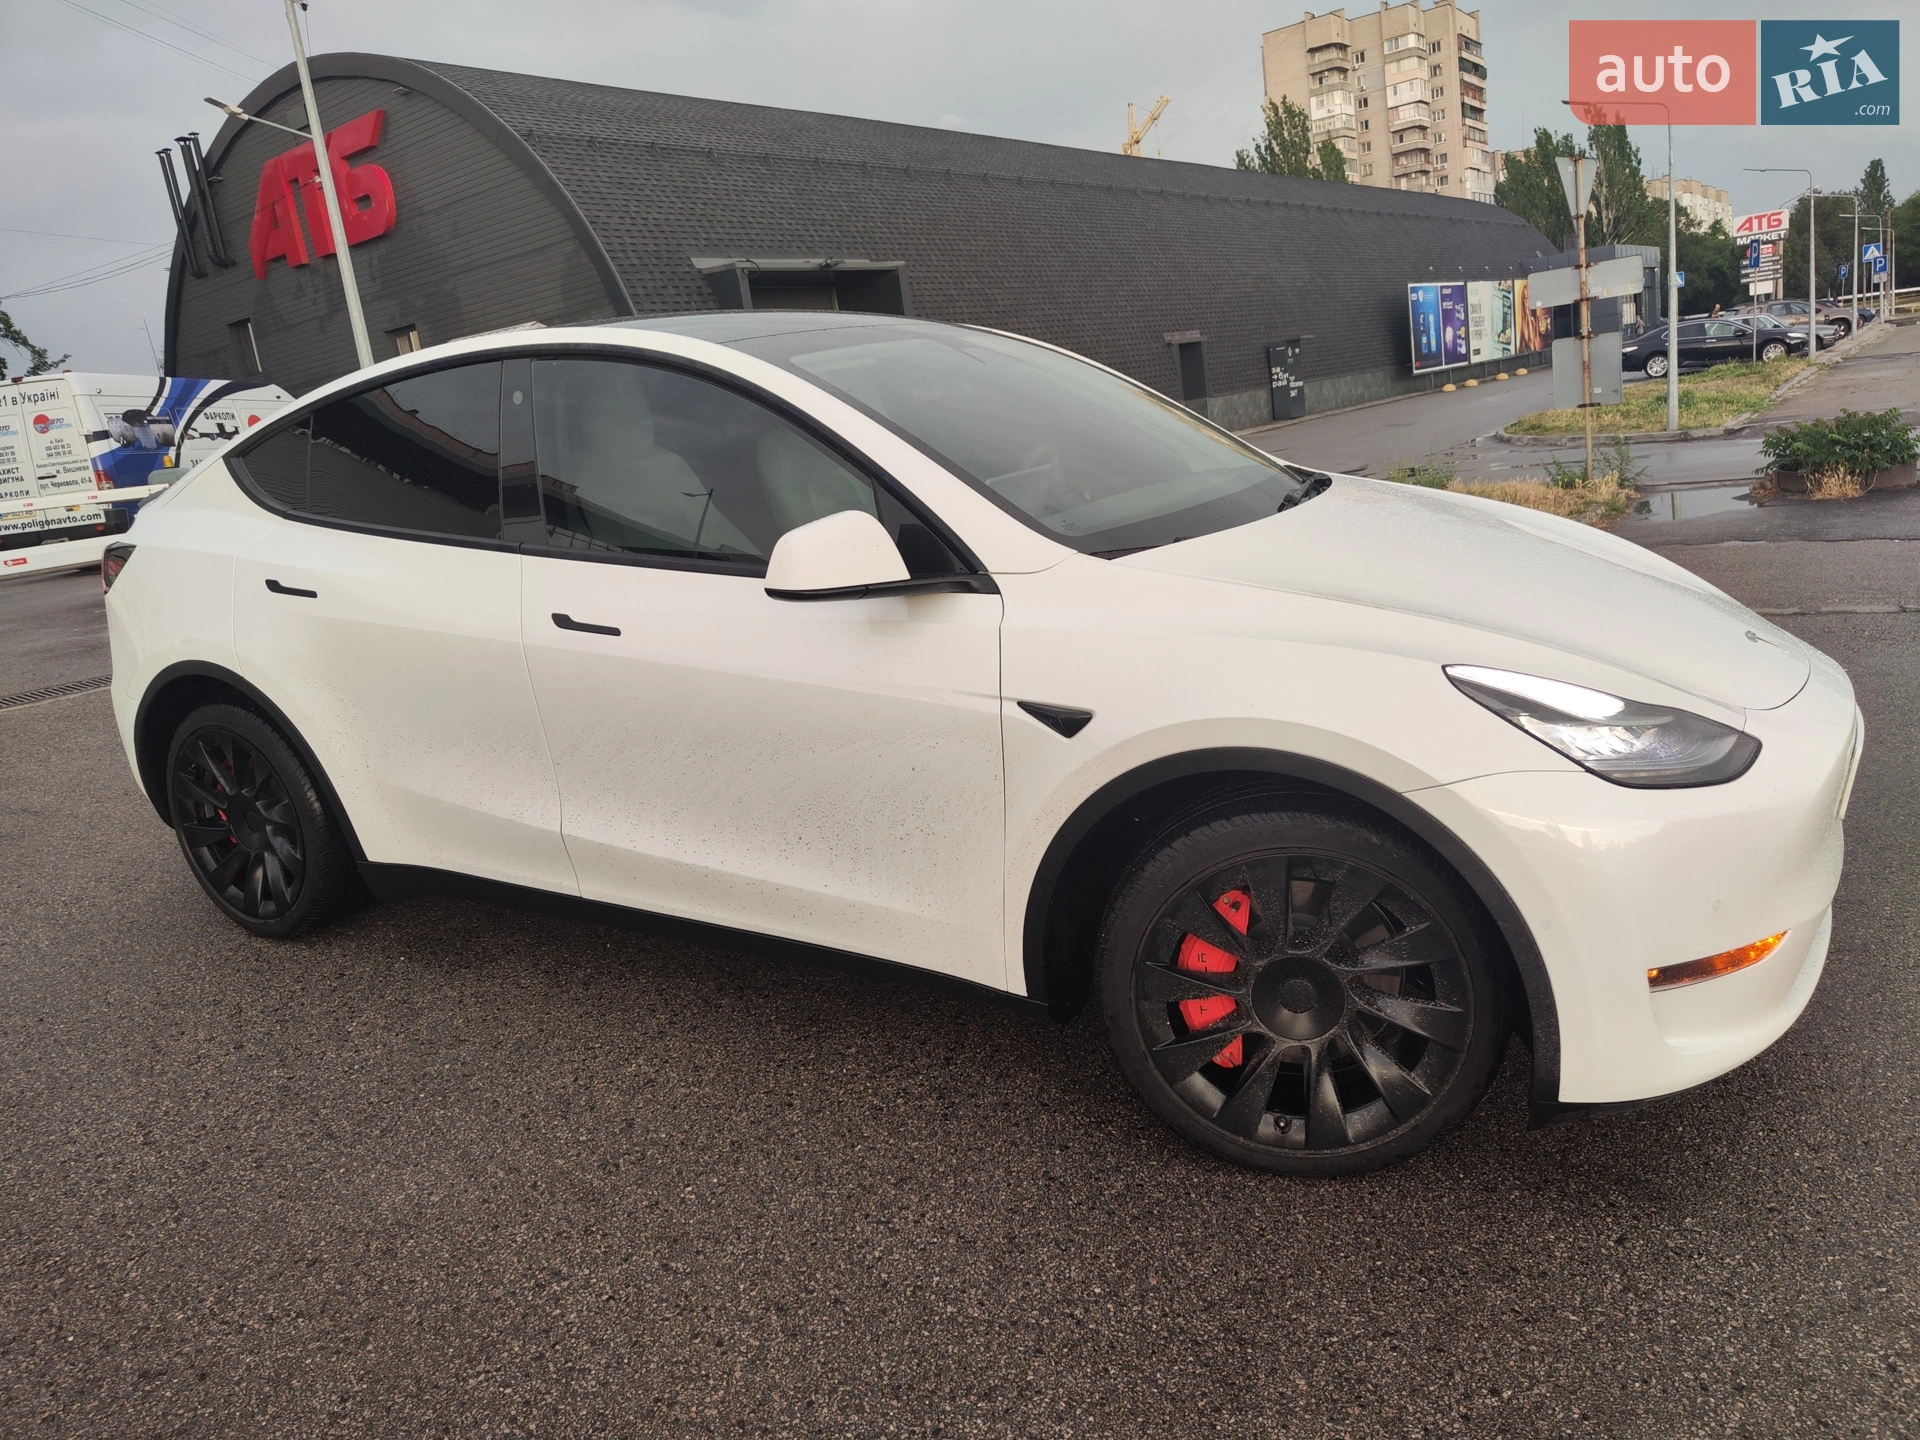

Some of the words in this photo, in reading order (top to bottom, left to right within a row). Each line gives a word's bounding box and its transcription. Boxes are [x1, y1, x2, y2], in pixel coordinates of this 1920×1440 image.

[248, 110, 397, 281] АТБ
[1736, 210, 1784, 234] АТБ
[1751, 242, 1758, 266] P
[1840, 266, 1847, 277] P
[1876, 257, 1885, 272] P
[11, 396, 18, 406] в
[19, 387, 60, 406] Україні
[203, 411, 237, 421] ФАРКОПИ
